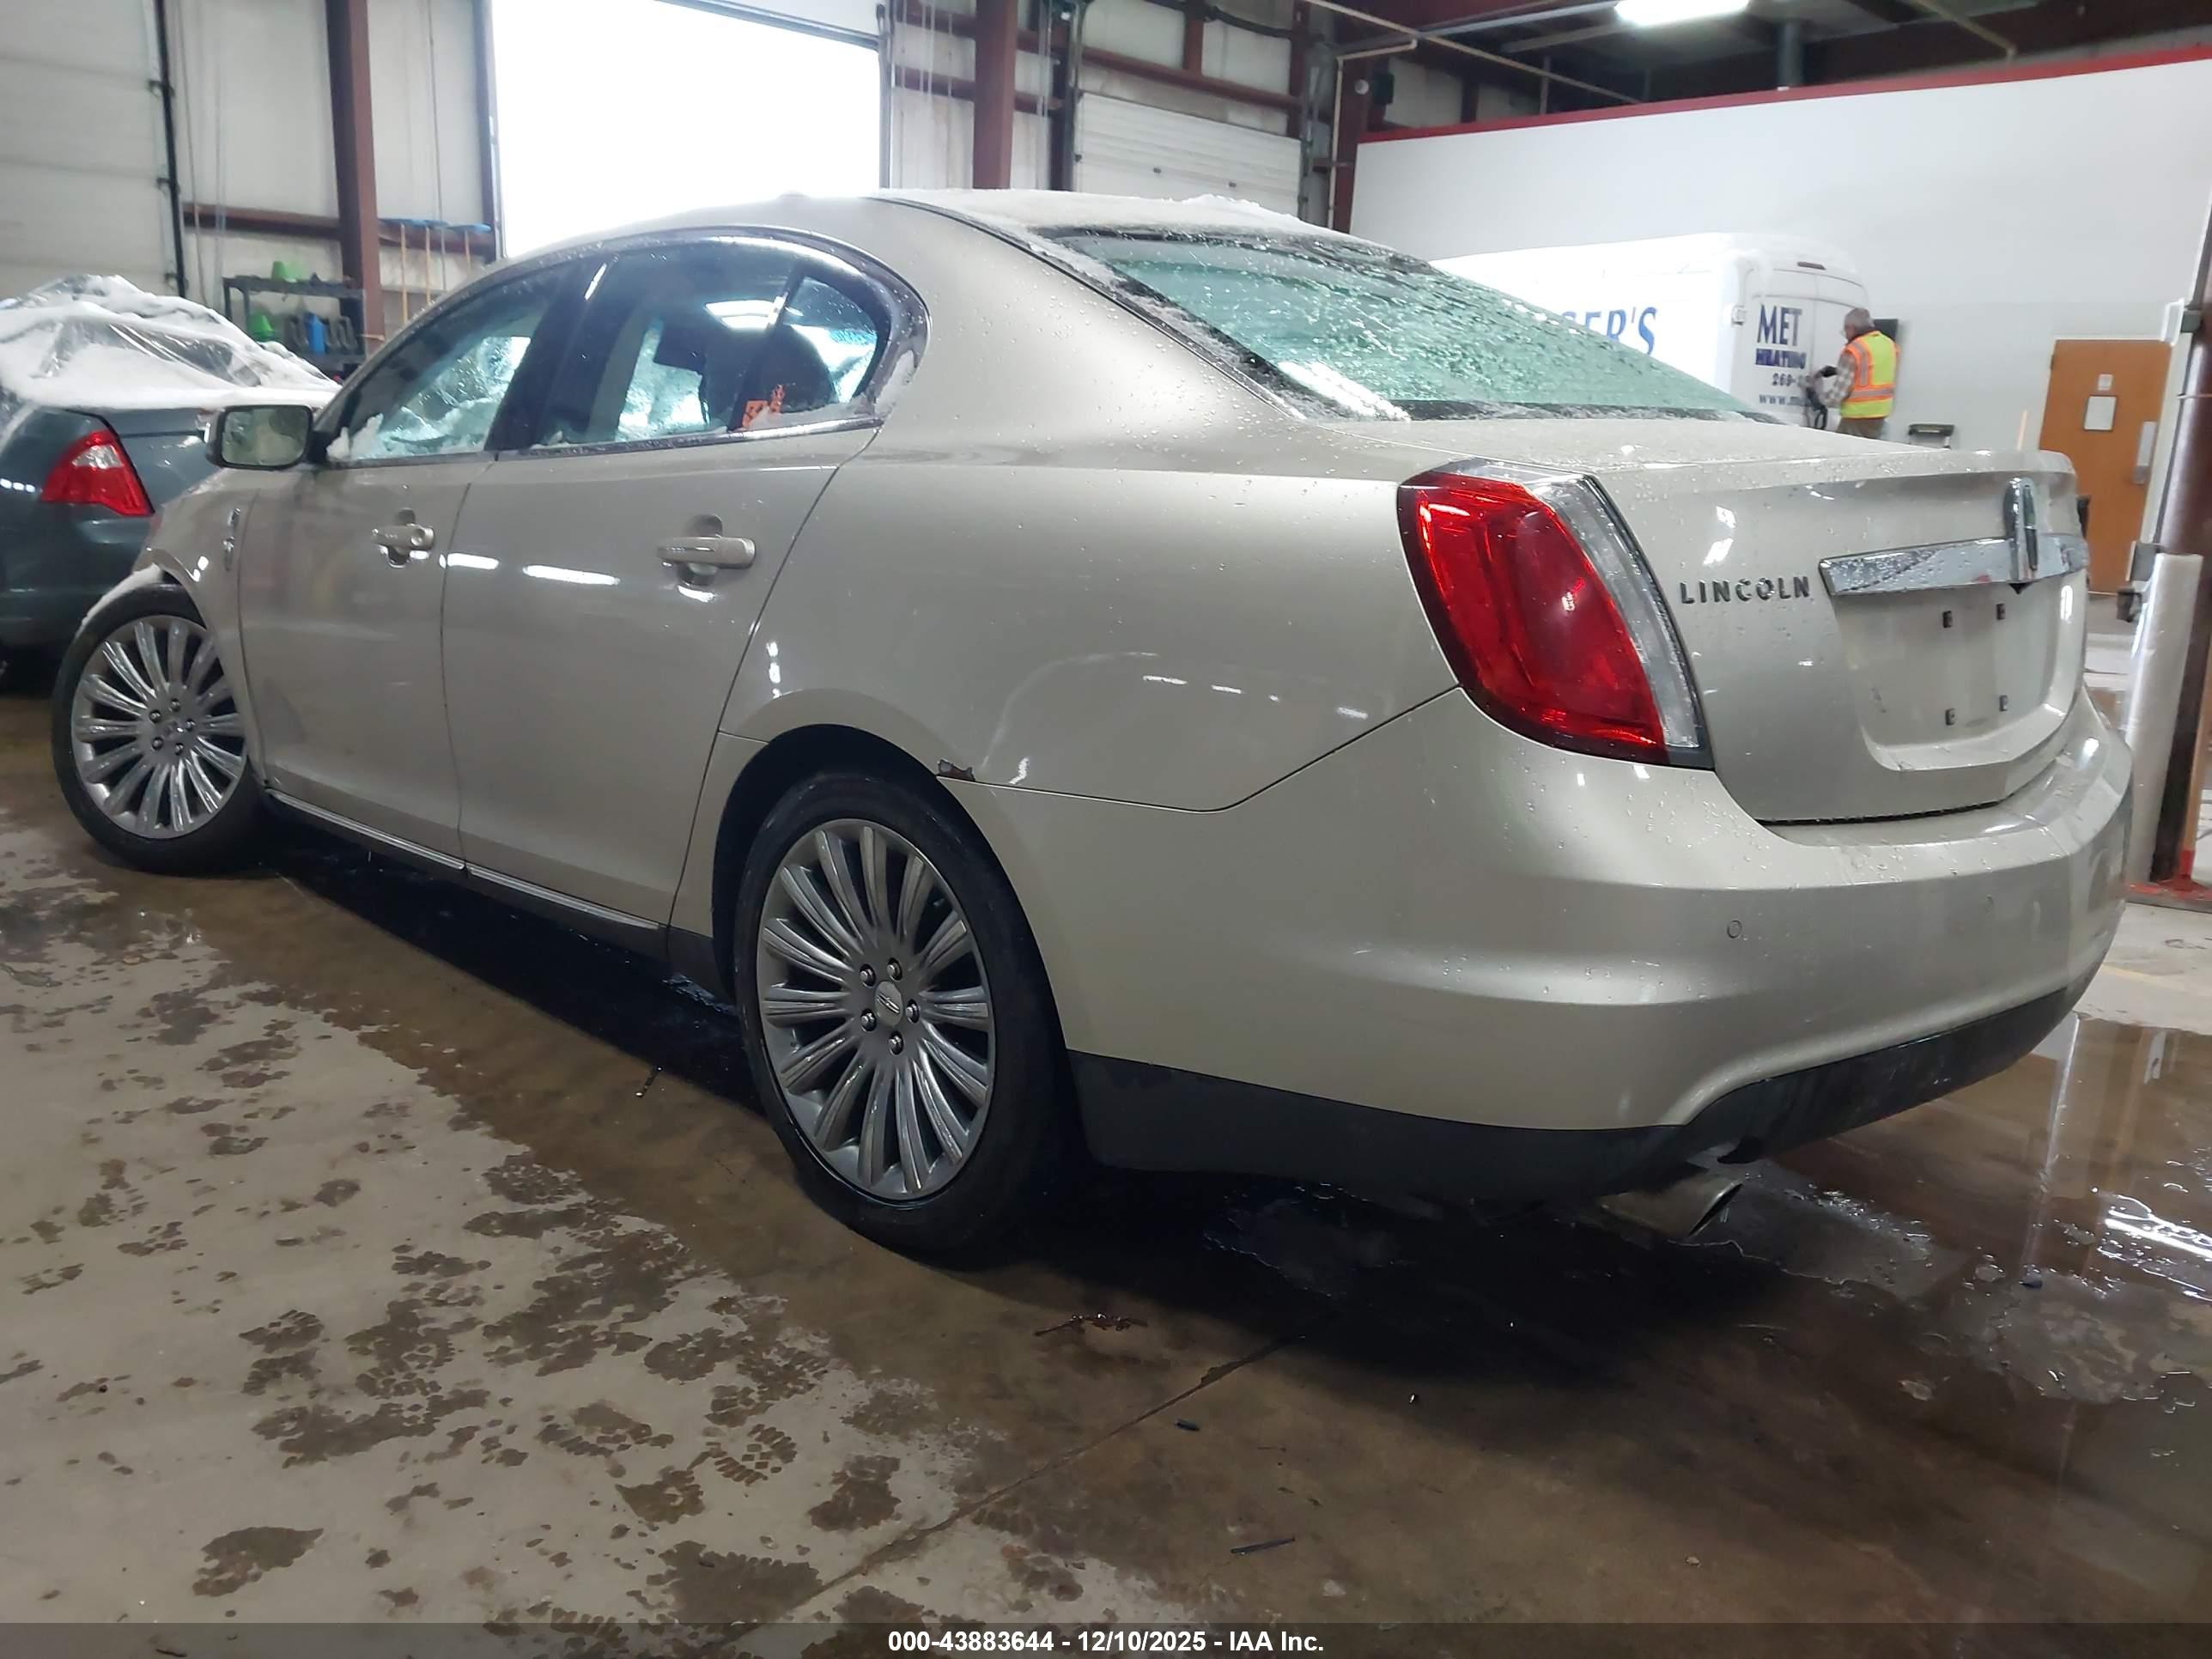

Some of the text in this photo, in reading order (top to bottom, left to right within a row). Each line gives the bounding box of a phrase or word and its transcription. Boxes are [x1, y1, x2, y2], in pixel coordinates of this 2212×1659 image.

[1562, 307, 1657, 356] R'S
[1756, 304, 1802, 346] MET
[1680, 576, 1809, 604] LINCOLN
